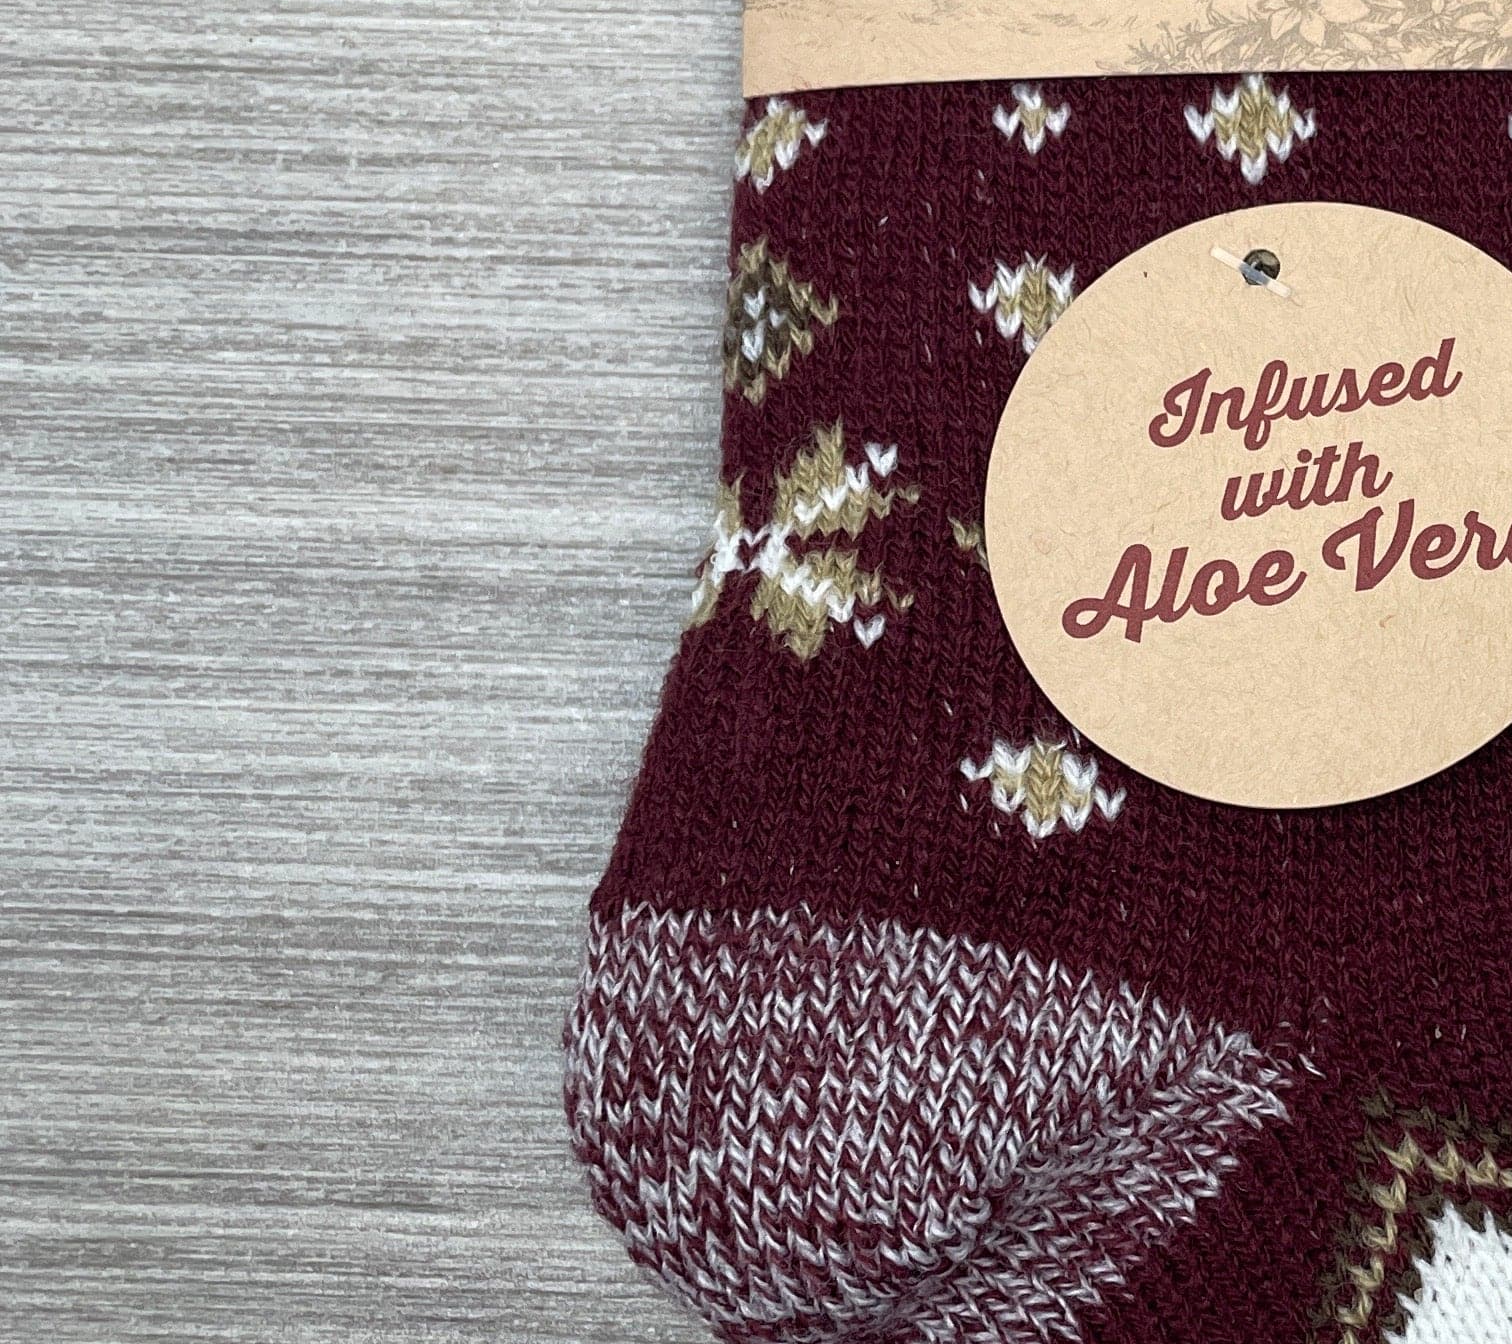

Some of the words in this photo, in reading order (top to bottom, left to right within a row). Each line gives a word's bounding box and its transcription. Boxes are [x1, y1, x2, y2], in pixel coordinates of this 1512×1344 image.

[1148, 337, 1463, 451] Infused
[1220, 441, 1393, 521] with
[1061, 543, 1307, 643] Aloe
